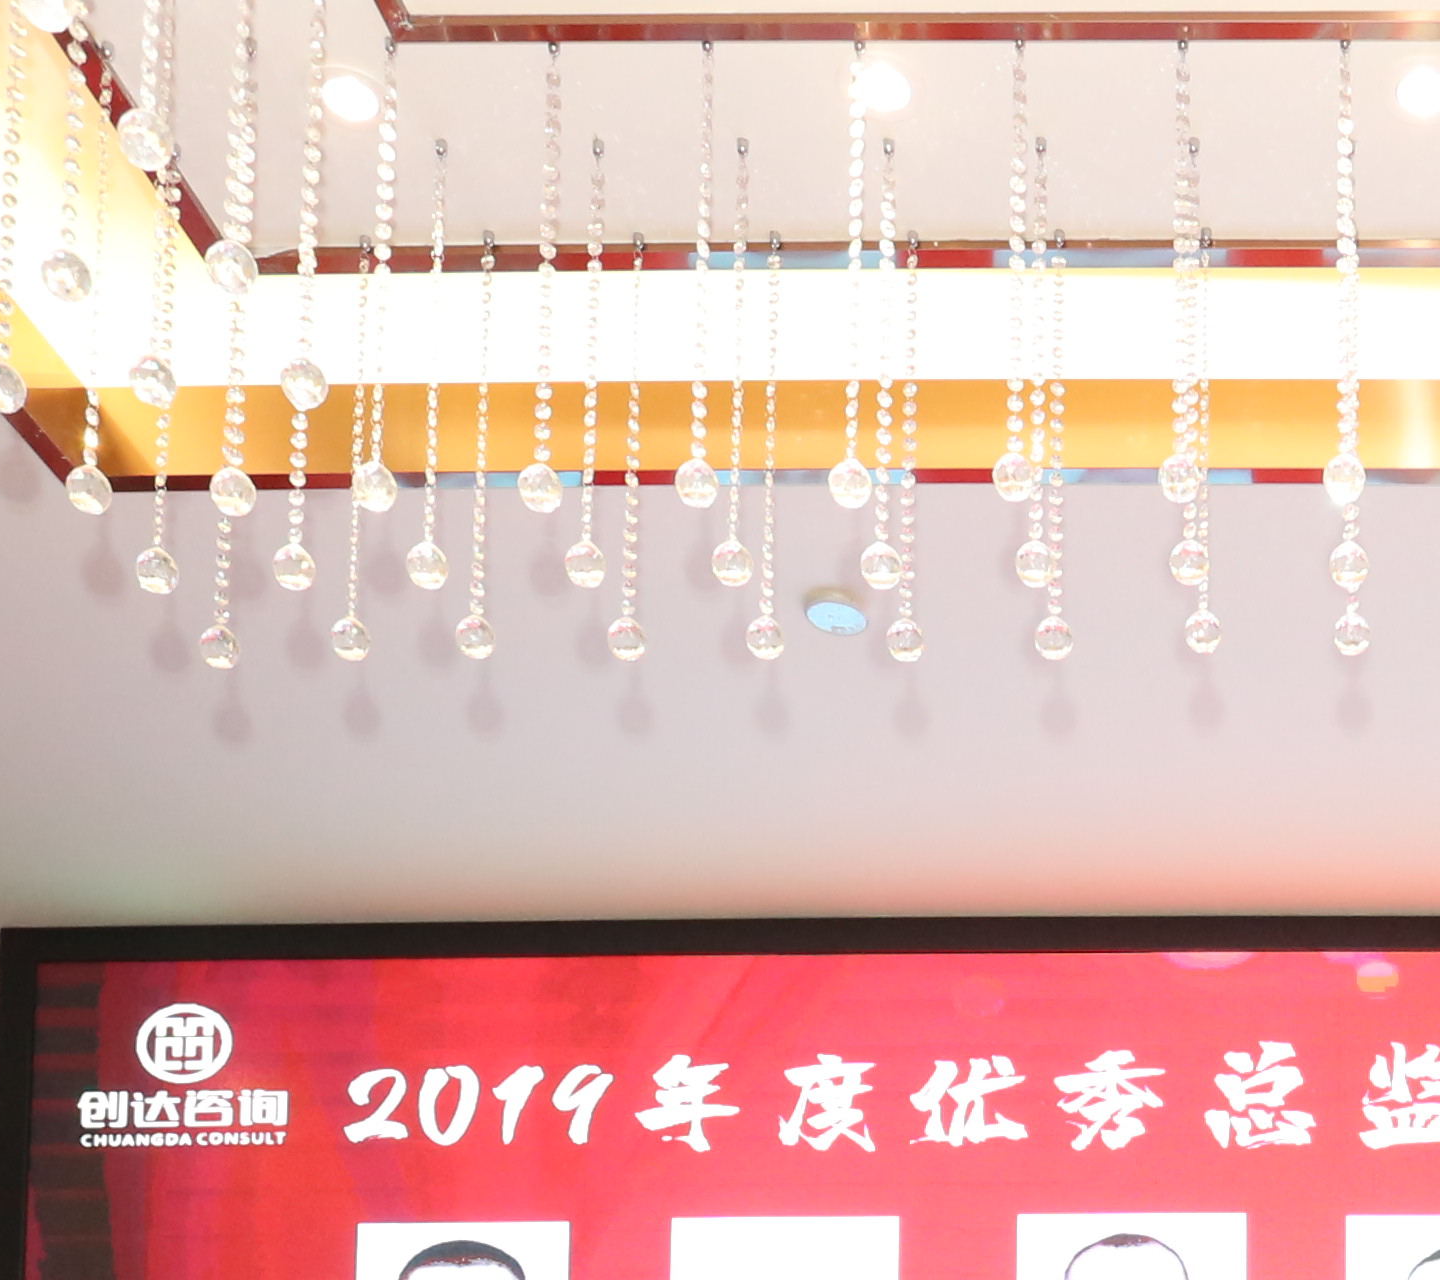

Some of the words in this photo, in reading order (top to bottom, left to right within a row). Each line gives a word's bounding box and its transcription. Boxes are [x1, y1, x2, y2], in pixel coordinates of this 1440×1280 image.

[77, 1089, 289, 1128] 创达咨询
[79, 1132, 192, 1148] CHUANGDA
[196, 1131, 287, 1146] CONSULT
